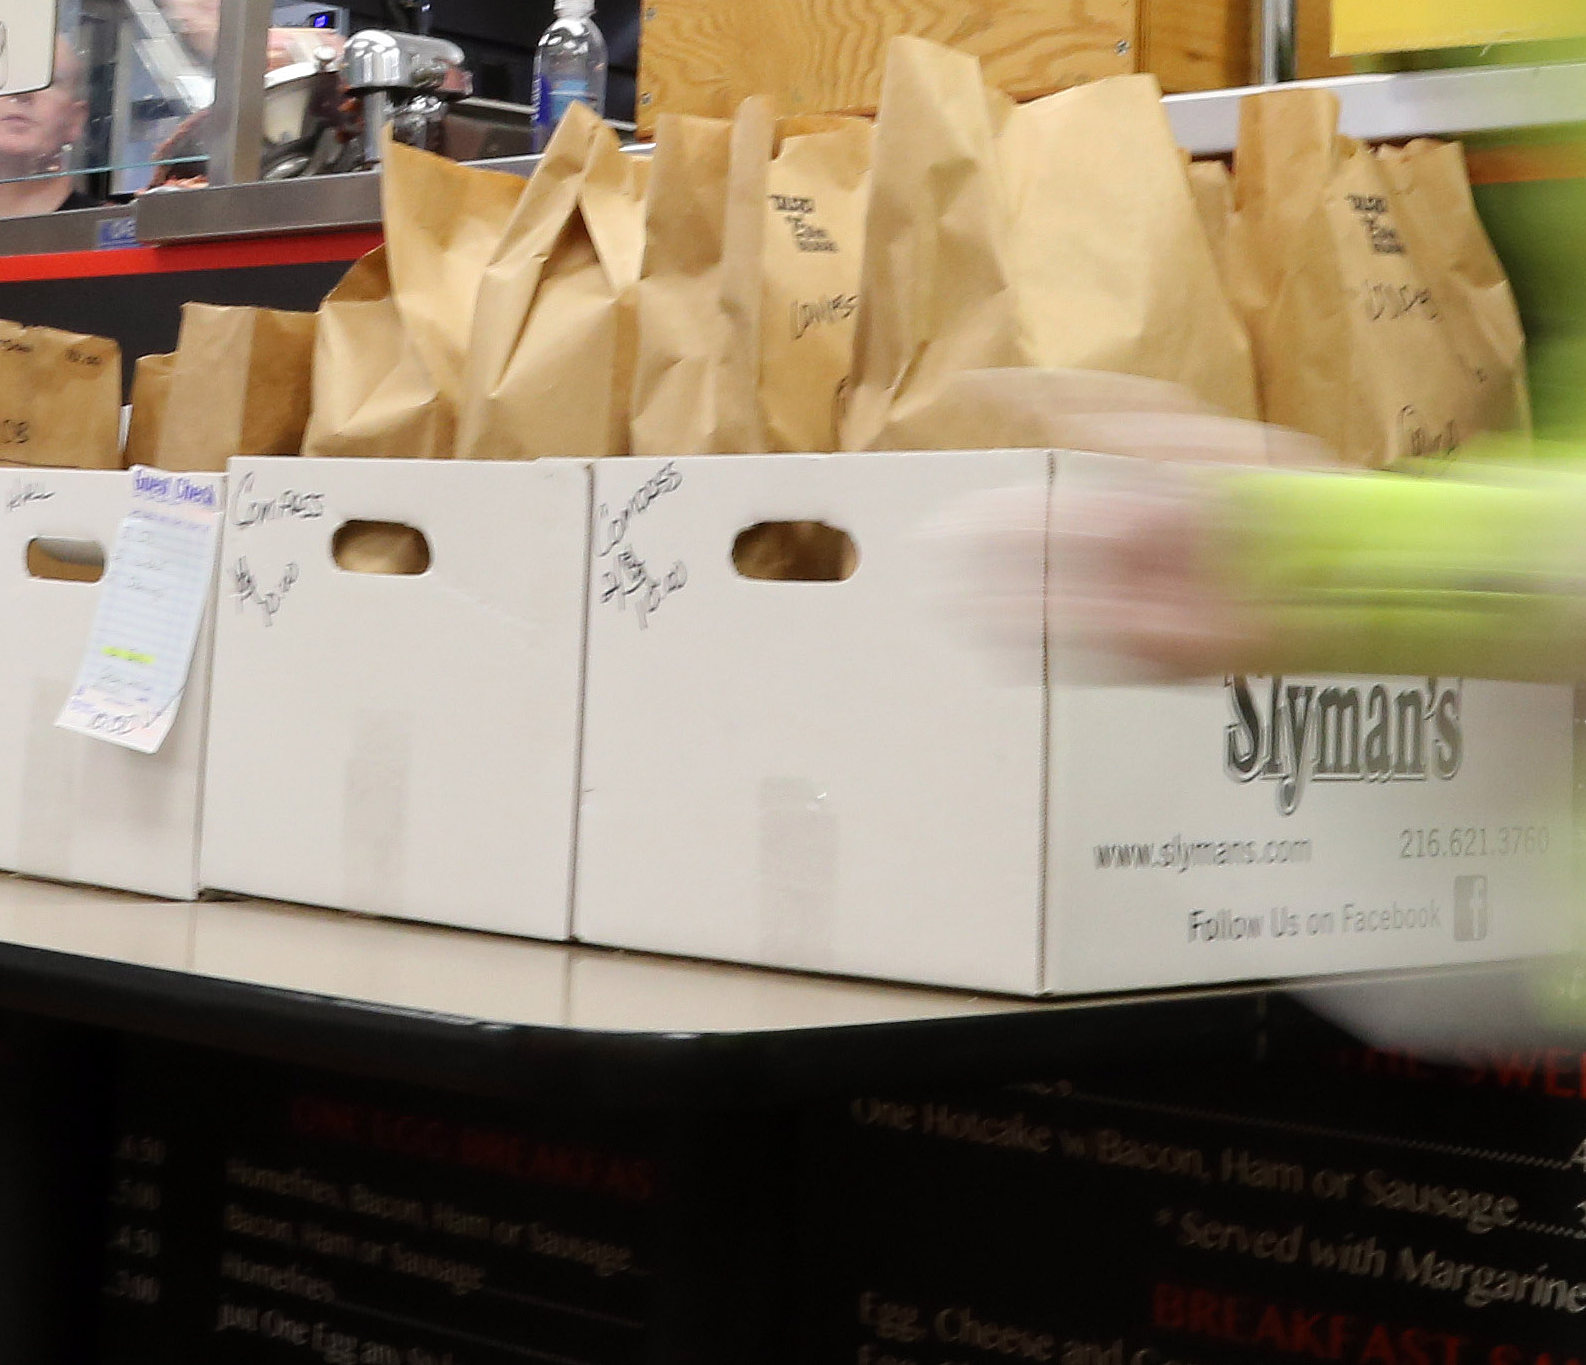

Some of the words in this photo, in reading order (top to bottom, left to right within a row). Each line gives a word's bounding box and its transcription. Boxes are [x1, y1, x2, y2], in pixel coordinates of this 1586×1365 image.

[1223, 674, 1464, 816] Slyman's
[1093, 836, 1312, 872] www.slymans.com
[1187, 907, 1262, 942] Follow
[1270, 906, 1299, 937] Us
[1307, 911, 1334, 936] on
[1342, 899, 1441, 933] Facebook
